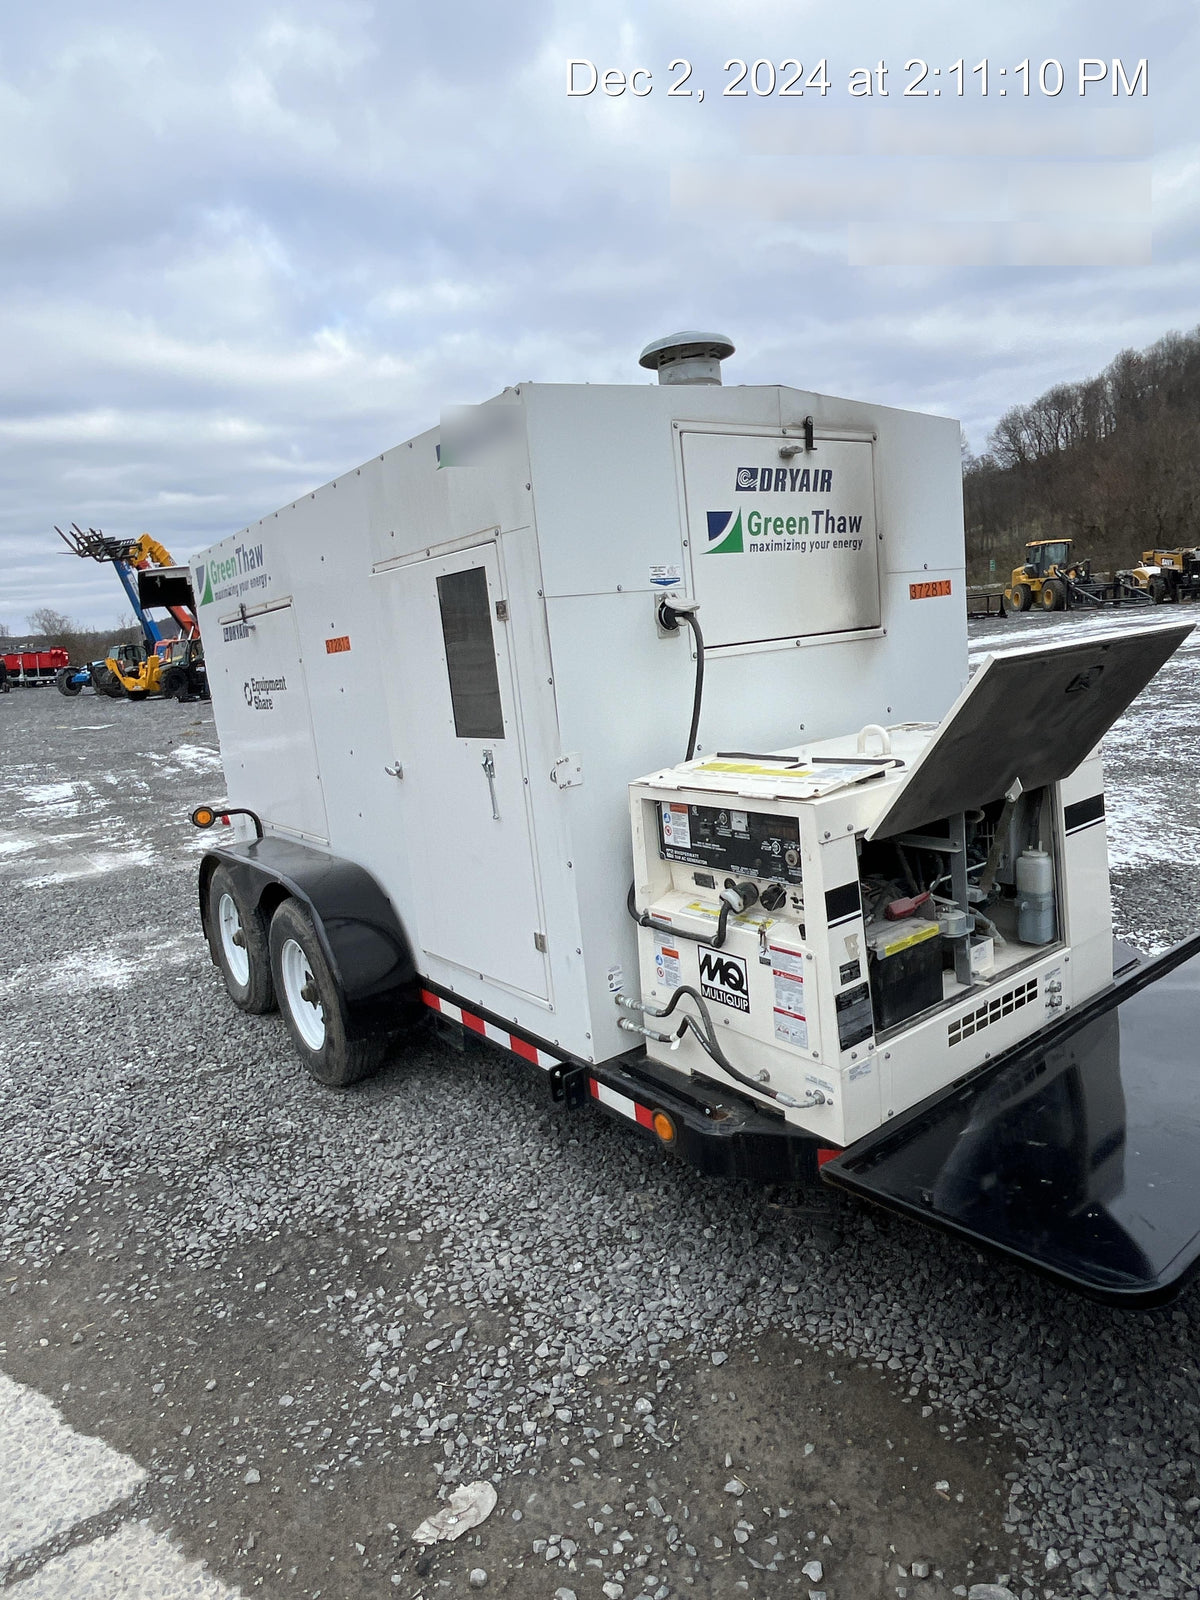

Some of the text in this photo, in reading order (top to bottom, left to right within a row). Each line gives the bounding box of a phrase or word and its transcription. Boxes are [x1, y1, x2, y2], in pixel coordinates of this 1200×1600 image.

[759, 467, 833, 493] DRYAIR
[749, 538, 863, 553] maximizing your energy
[910, 580, 951, 600] 372813
[251, 675, 288, 696] Equipment
[253, 695, 274, 710] Share
[699, 953, 748, 996] MQ
[702, 984, 749, 1011] MULTIQUIP
